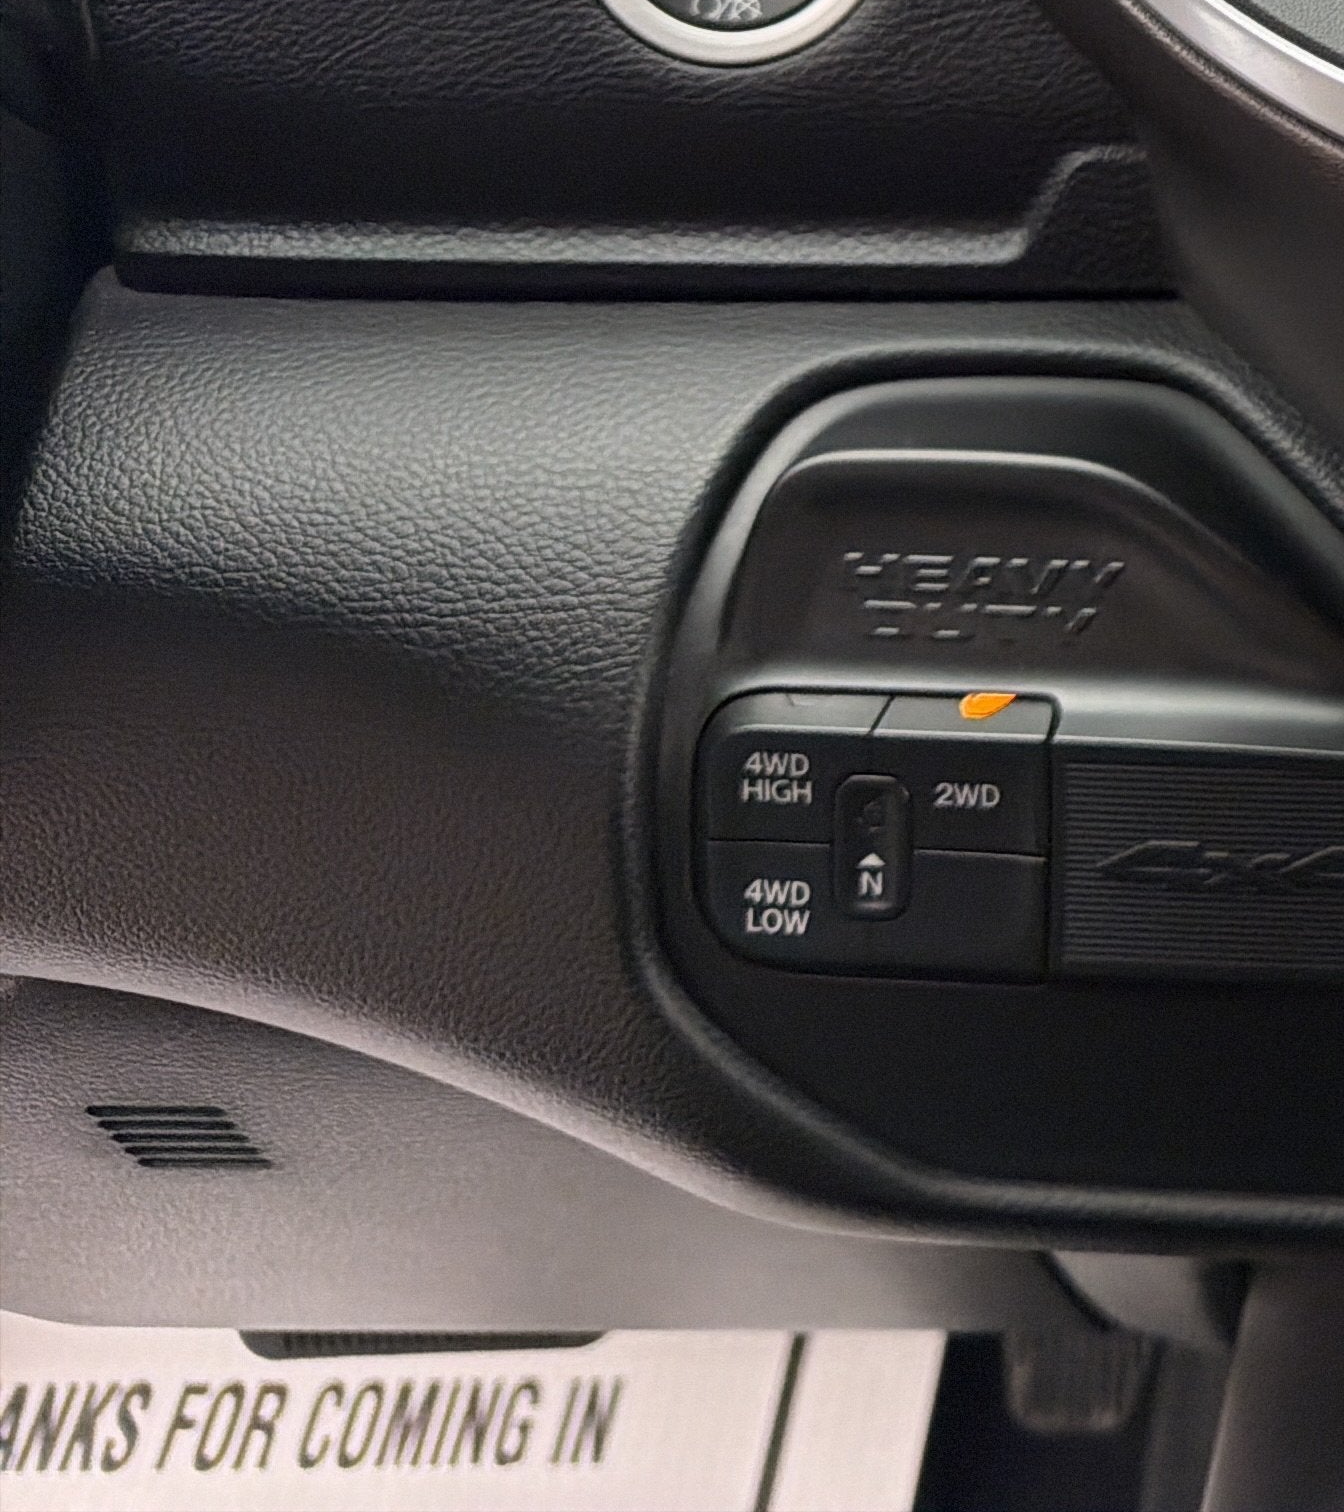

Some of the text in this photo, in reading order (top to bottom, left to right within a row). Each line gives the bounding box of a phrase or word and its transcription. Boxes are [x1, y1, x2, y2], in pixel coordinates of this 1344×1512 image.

[744, 751, 810, 777] 4WD
[740, 779, 813, 806] HIGH
[933, 782, 1000, 809] 2WD
[744, 879, 811, 906] 4WD
[857, 871, 884, 897] N
[745, 908, 811, 935] LOW
[155, 1381, 290, 1471] FOR
[298, 1377, 542, 1469] COMING
[550, 1374, 625, 1464] IN
